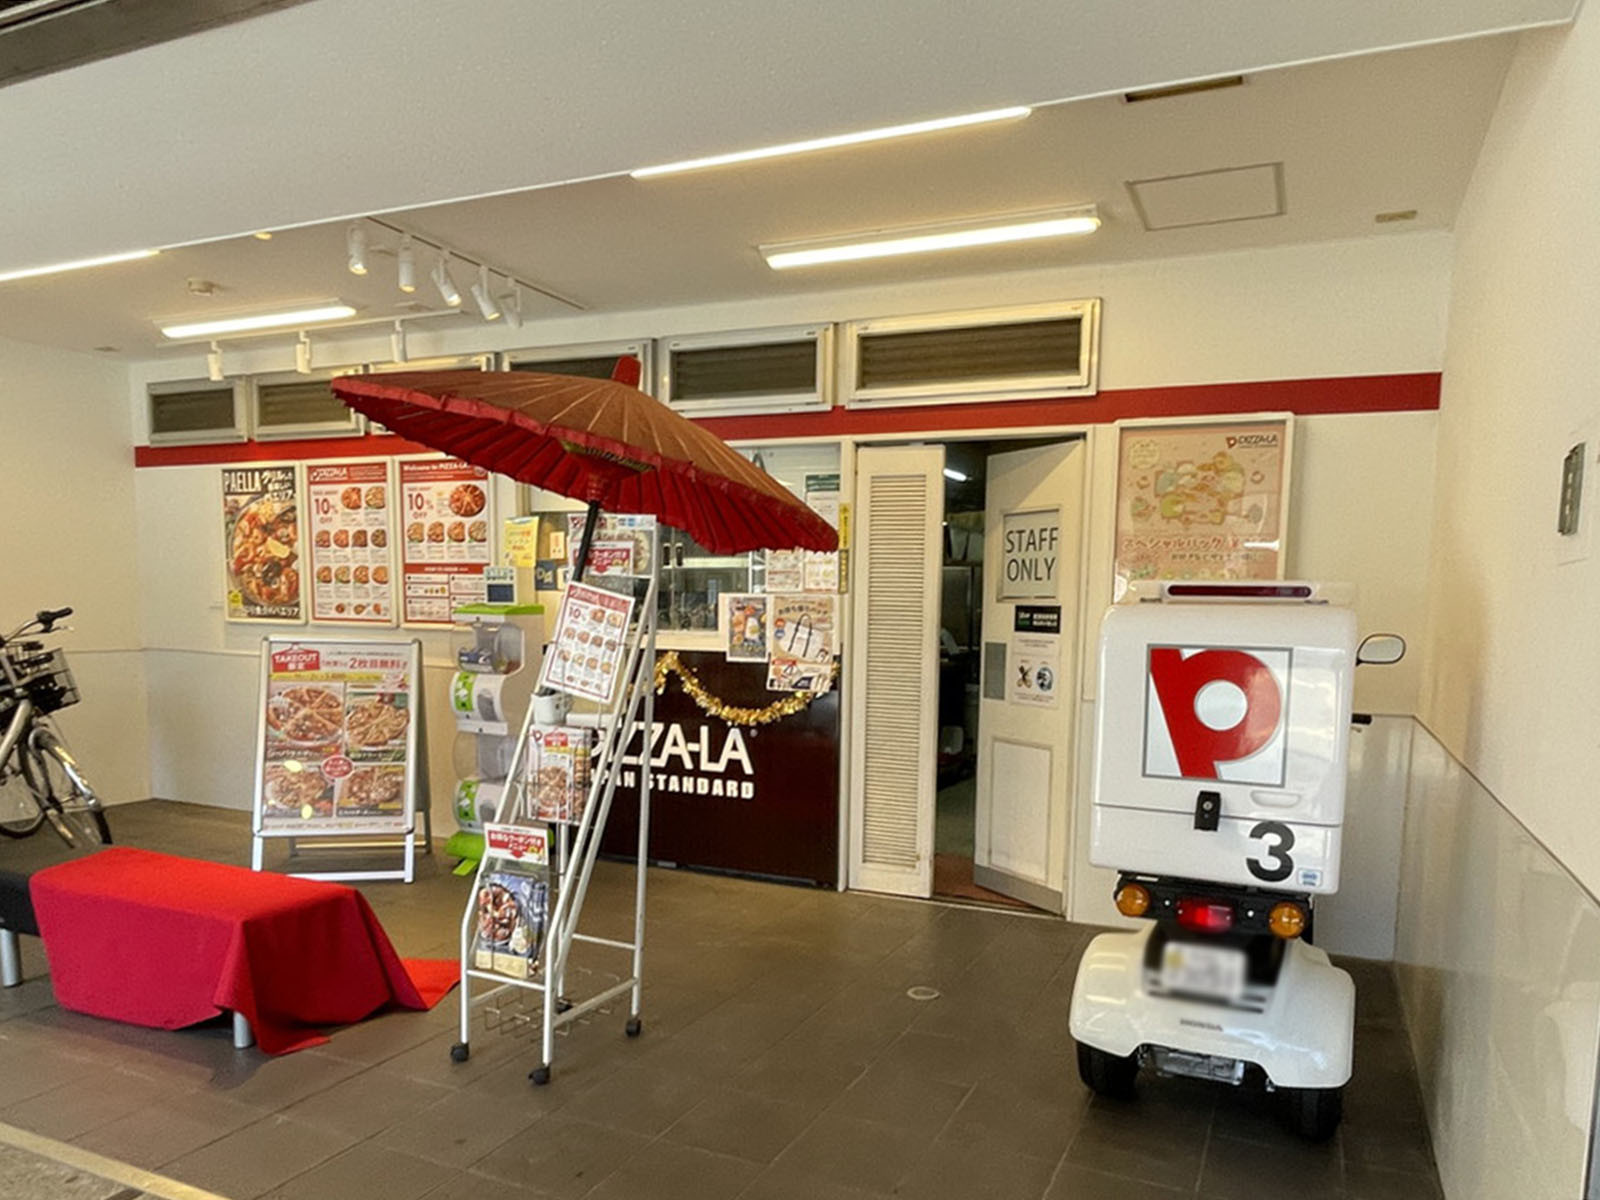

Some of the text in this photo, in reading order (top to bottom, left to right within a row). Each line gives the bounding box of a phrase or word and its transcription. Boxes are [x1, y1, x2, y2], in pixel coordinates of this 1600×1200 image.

[224, 471, 261, 493] PAELLA
[1006, 527, 1059, 553] STAFF
[1007, 557, 1056, 582] ONLY
[274, 652, 318, 663] TAKEOUT
[590, 718, 754, 775] ZZA-LA
[1246, 821, 1295, 883] 3
